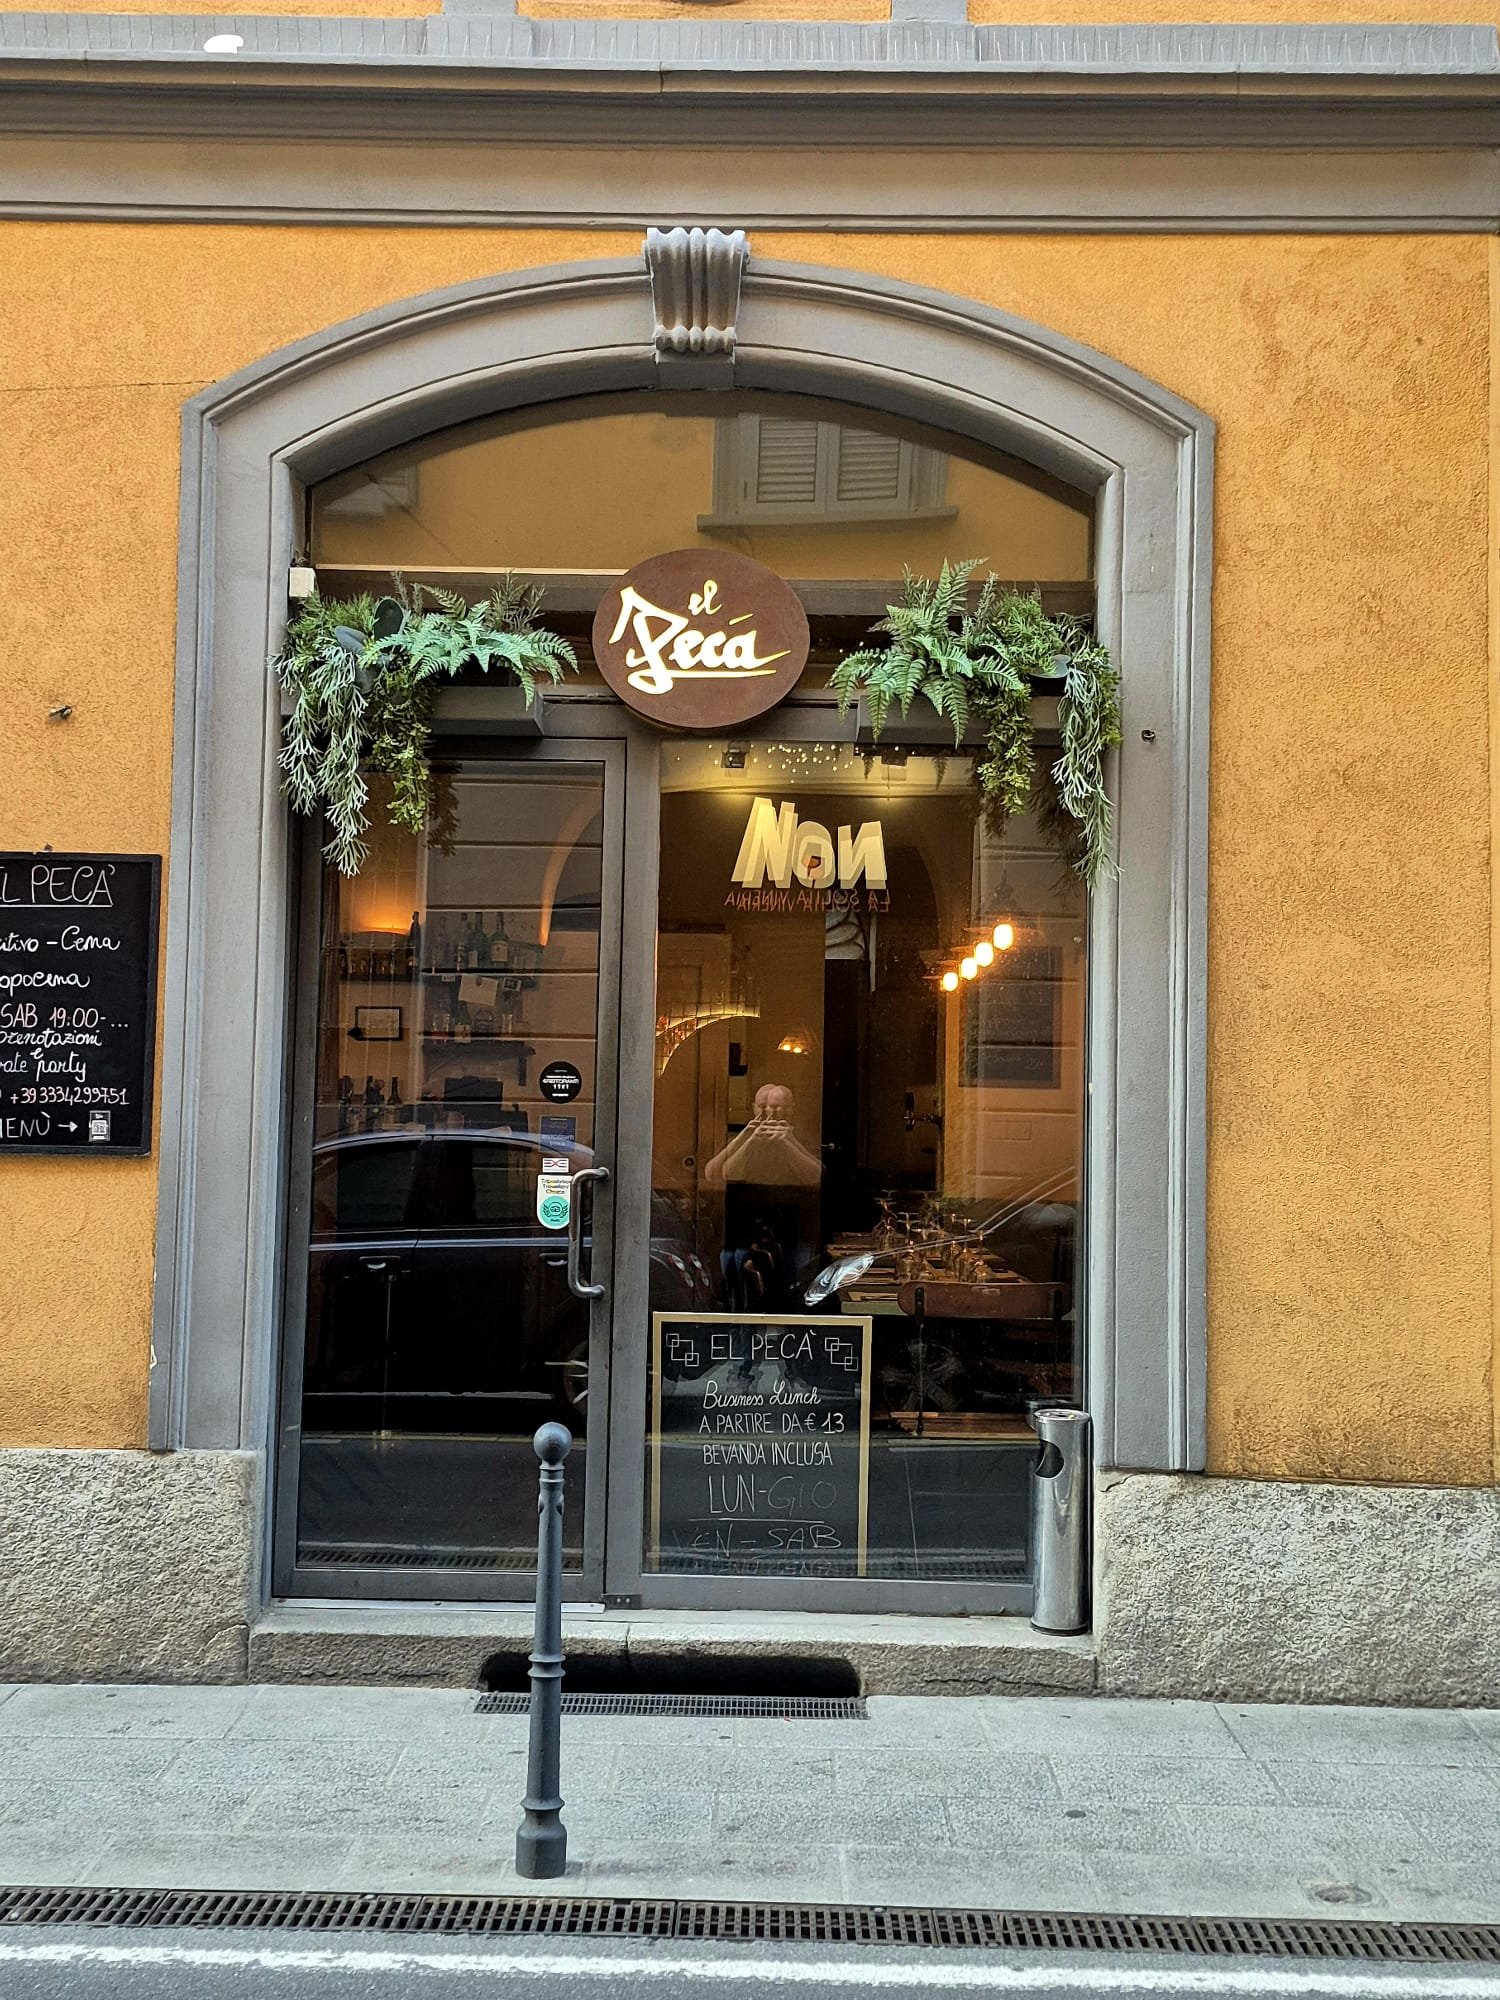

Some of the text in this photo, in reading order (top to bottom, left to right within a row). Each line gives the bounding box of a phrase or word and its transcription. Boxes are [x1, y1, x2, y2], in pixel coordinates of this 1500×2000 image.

[688, 580, 722, 616] el
[0, 866, 21, 903] L
[0, 971, 90, 997] opocena
[0, 1003, 38, 1028] SAB
[36, 1051, 86, 1082] party
[711, 1334, 744, 1360] EL
[703, 1378, 821, 1409] Business Lunch
[698, 1414, 711, 1434] A
[716, 1412, 775, 1434] PARTIRE
[820, 1411, 845, 1434] 13
[703, 1441, 833, 1466] BEVANDA INCLUSA
[766, 1524, 842, 1551] SAB
